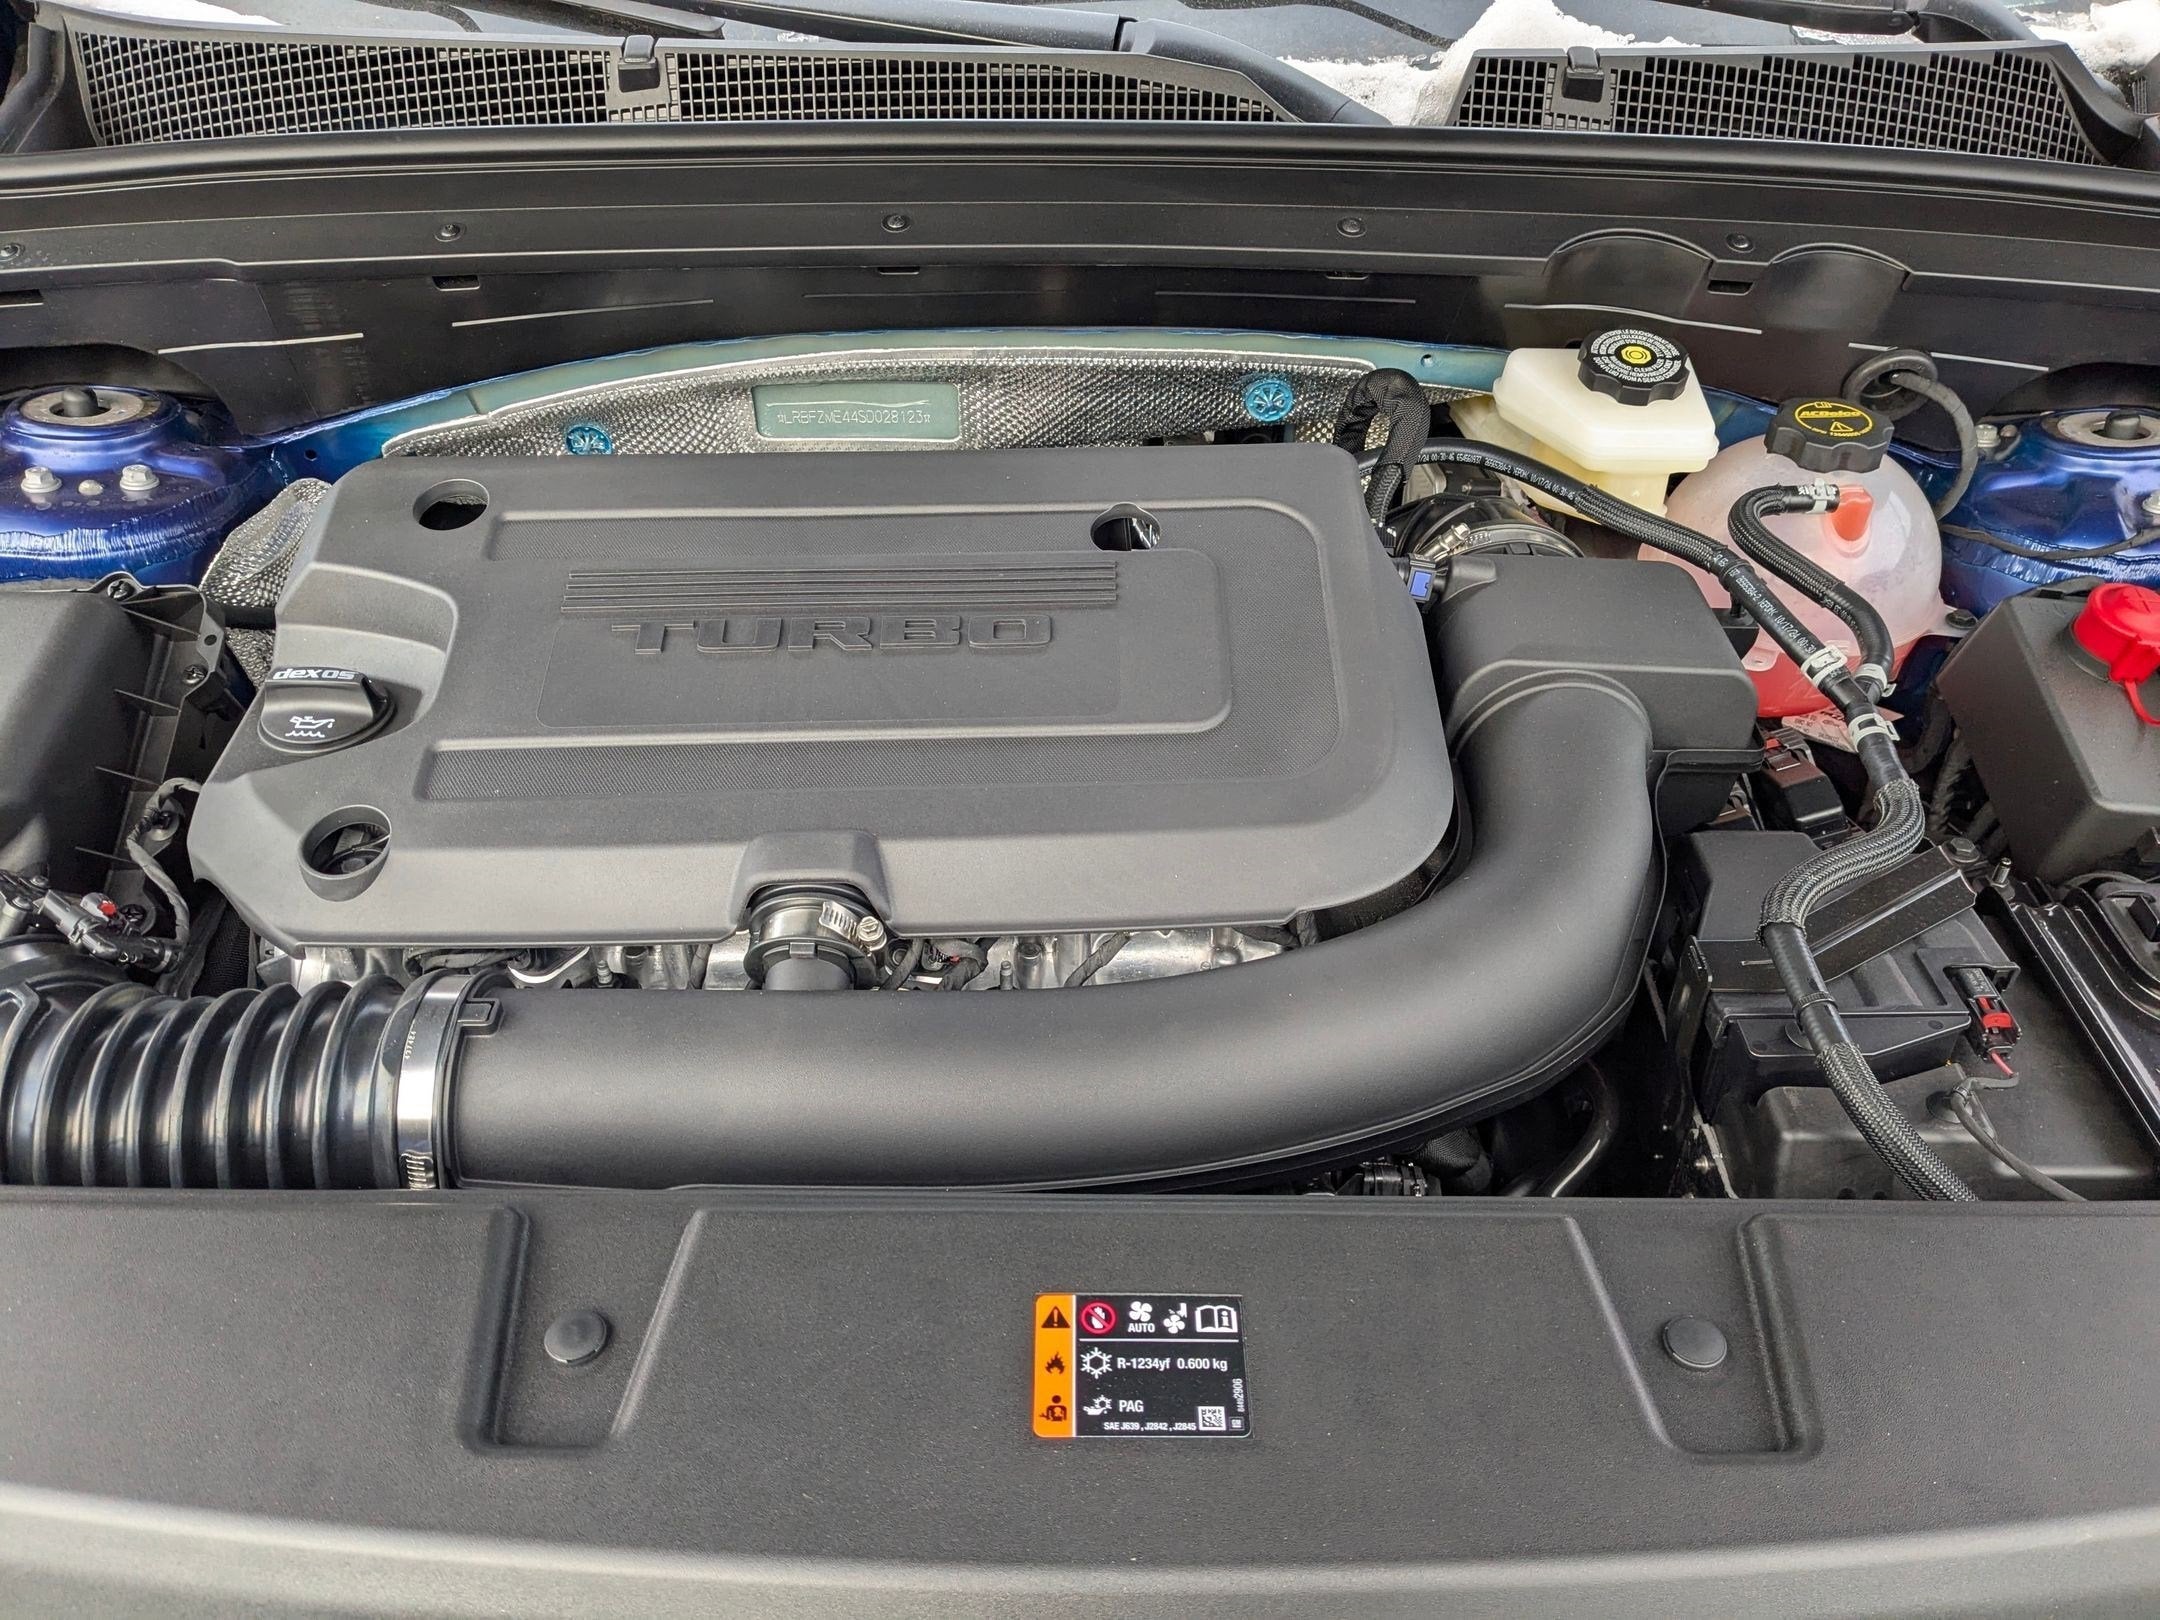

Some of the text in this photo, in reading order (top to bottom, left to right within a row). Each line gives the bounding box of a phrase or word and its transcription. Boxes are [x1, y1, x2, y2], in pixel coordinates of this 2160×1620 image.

[611, 614, 1054, 655] TURBO
[1775, 614, 1801, 639] 10/17/24
[1797, 636, 1817, 654] 00:30
[272, 668, 359, 680] dexos
[1128, 1322, 1155, 1333] AUTO
[1117, 1357, 1228, 1372] R-1234yf 0.600 kg
[1118, 1400, 1145, 1413] PAG
[1103, 1422, 1119, 1430] SAE
